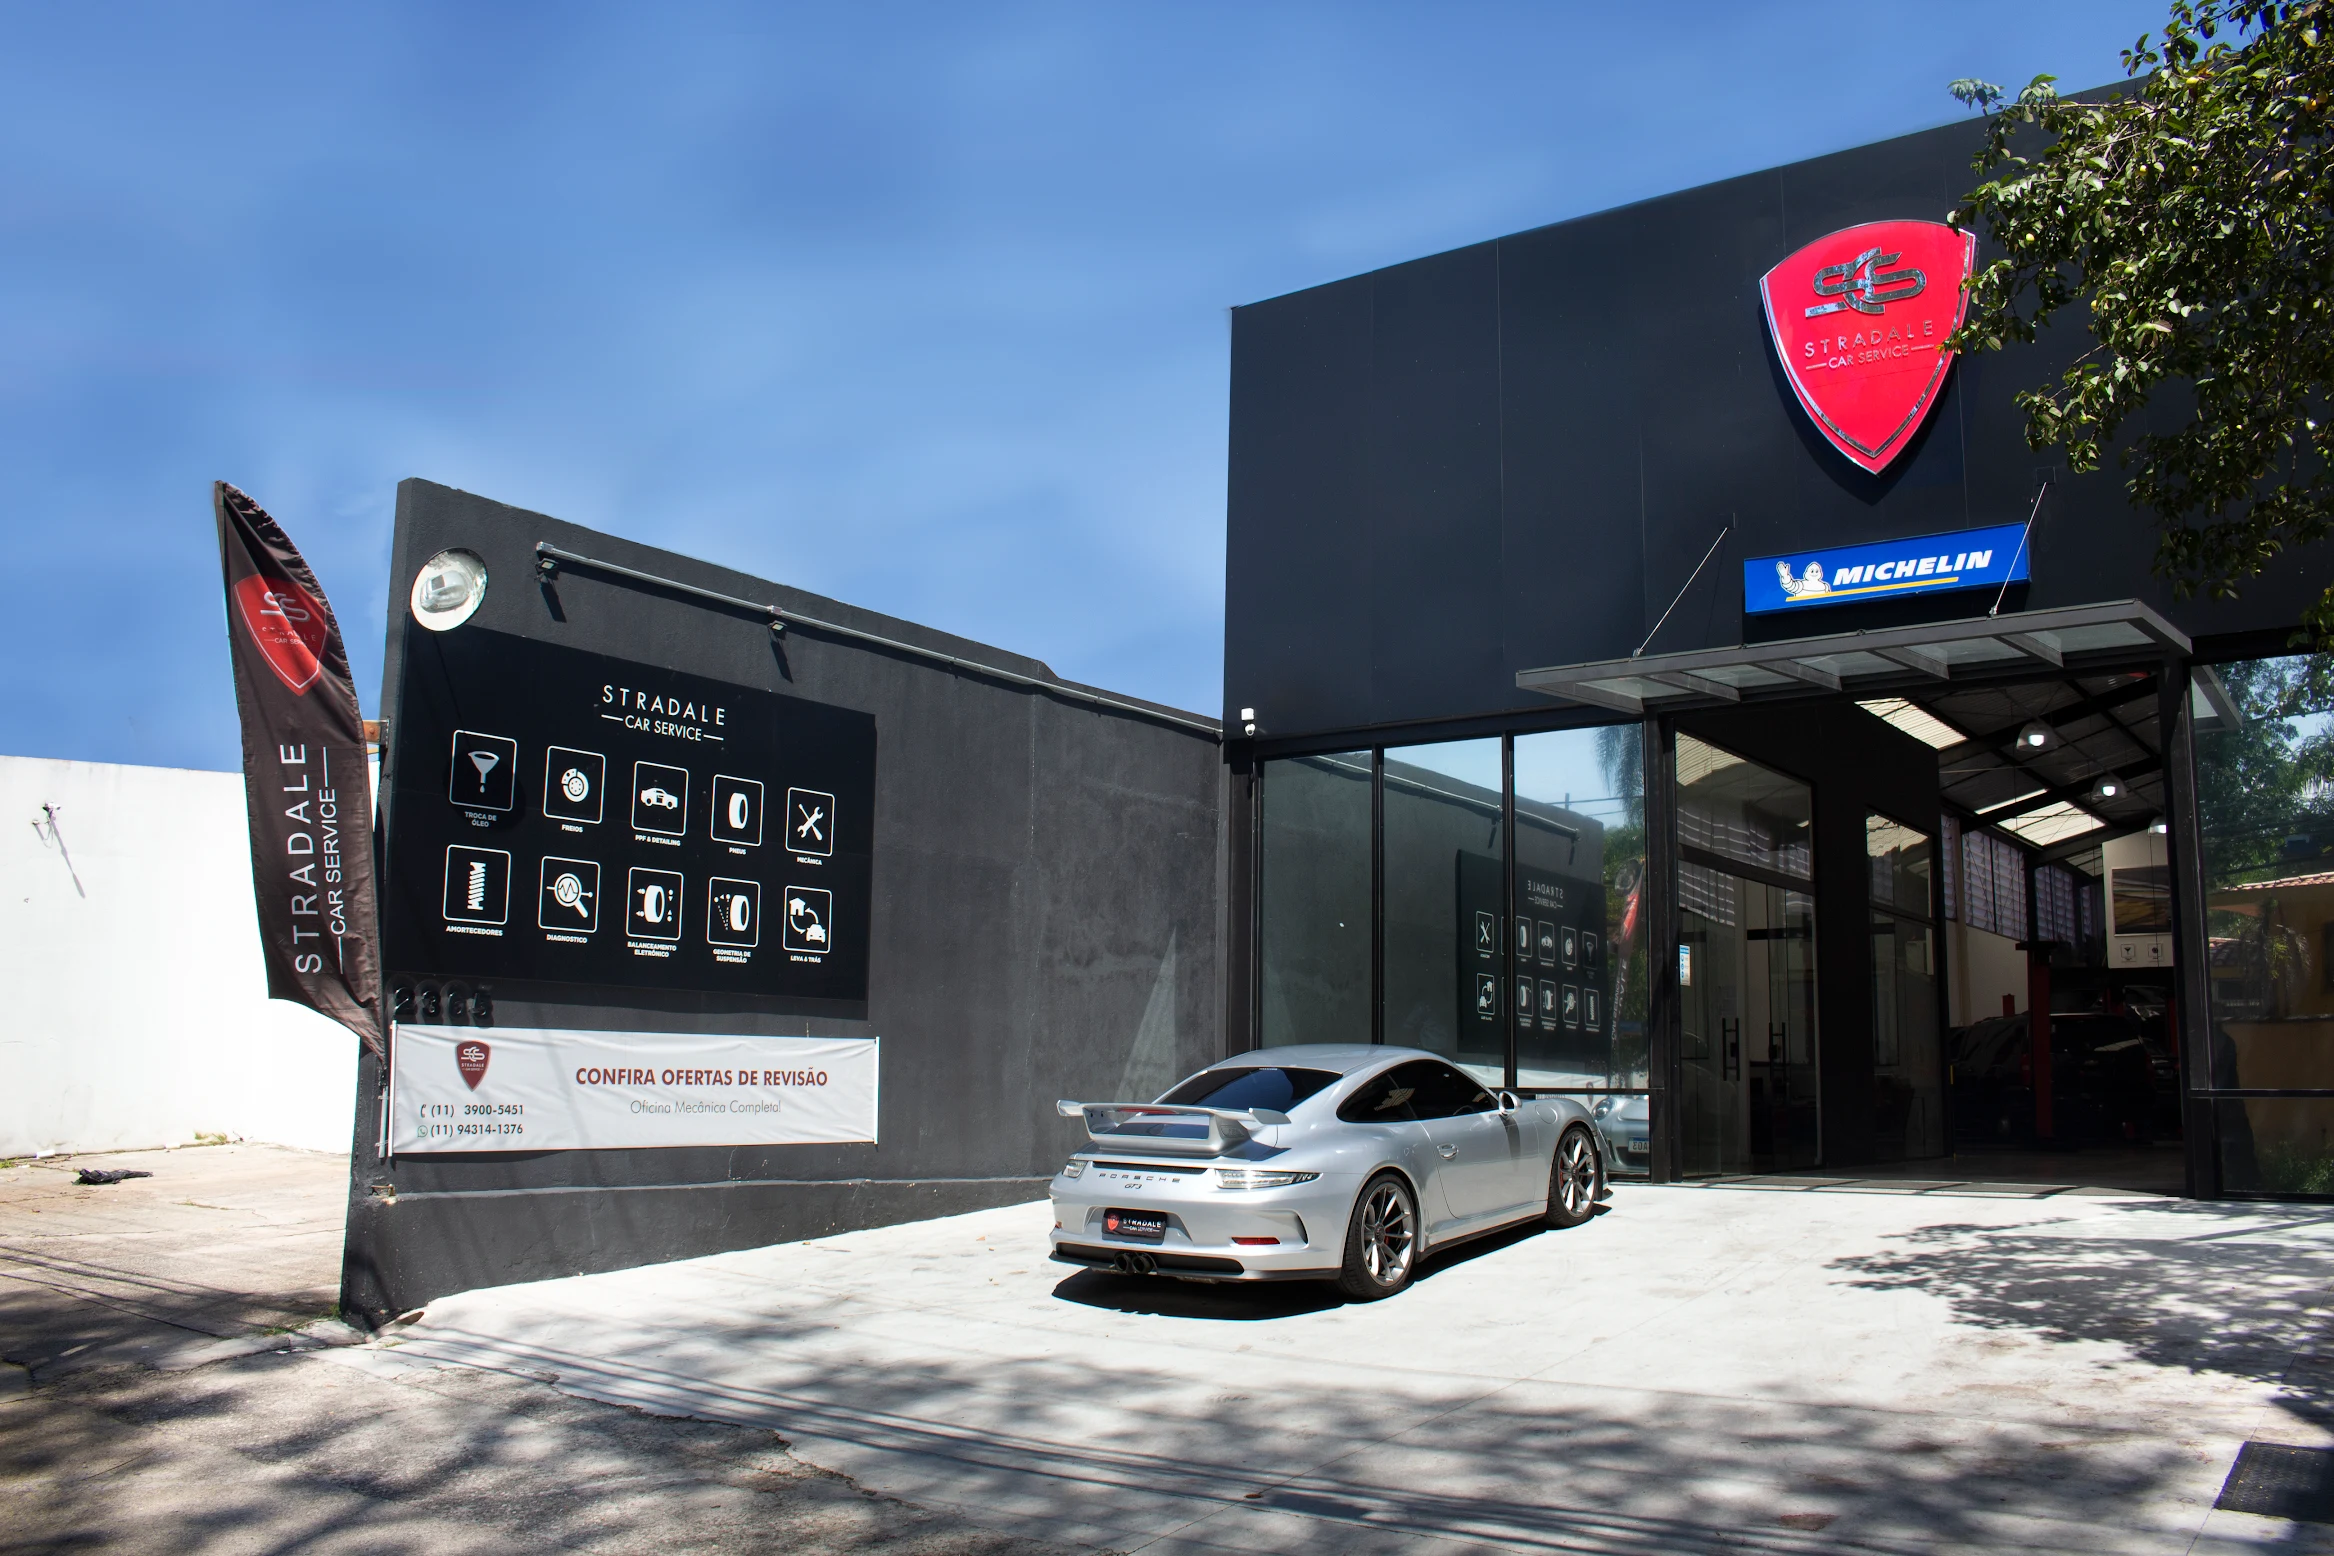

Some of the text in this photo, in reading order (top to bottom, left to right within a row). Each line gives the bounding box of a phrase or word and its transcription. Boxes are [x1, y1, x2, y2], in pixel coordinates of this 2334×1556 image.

[1804, 319, 1933, 358] STRADALE
[1828, 344, 1909, 369] CAR SERVICE
[1832, 549, 1993, 586] MICHELIN
[602, 684, 725, 726] STRADALE
[625, 715, 702, 741] CAR SERVICE
[464, 811, 497, 822] TROCA DE
[471, 819, 490, 828] ÓLEO
[561, 824, 584, 833] FREIOS
[634, 834, 647, 842] PPF
[651, 836, 681, 847] DETAILING
[728, 847, 747, 855] PNEUS
[279, 743, 323, 974] STRADALE
[318, 788, 347, 935] CAR SERVICE
[445, 925, 504, 937] AMORTECEDORES
[627, 941, 677, 952] BALANCEAMENTO
[712, 948, 743, 957] GEOMETRIA
[575, 1067, 828, 1087] CONFIRA OFERTAS DE REVISÃO
[431, 1104, 524, 1118] (11) 3900-5451
[630, 1099, 782, 1116] Oficina Mecânica Completa!
[430, 1123, 524, 1138] (11) 94314-1376
[1098, 1172, 1181, 1183] PORSCHE
